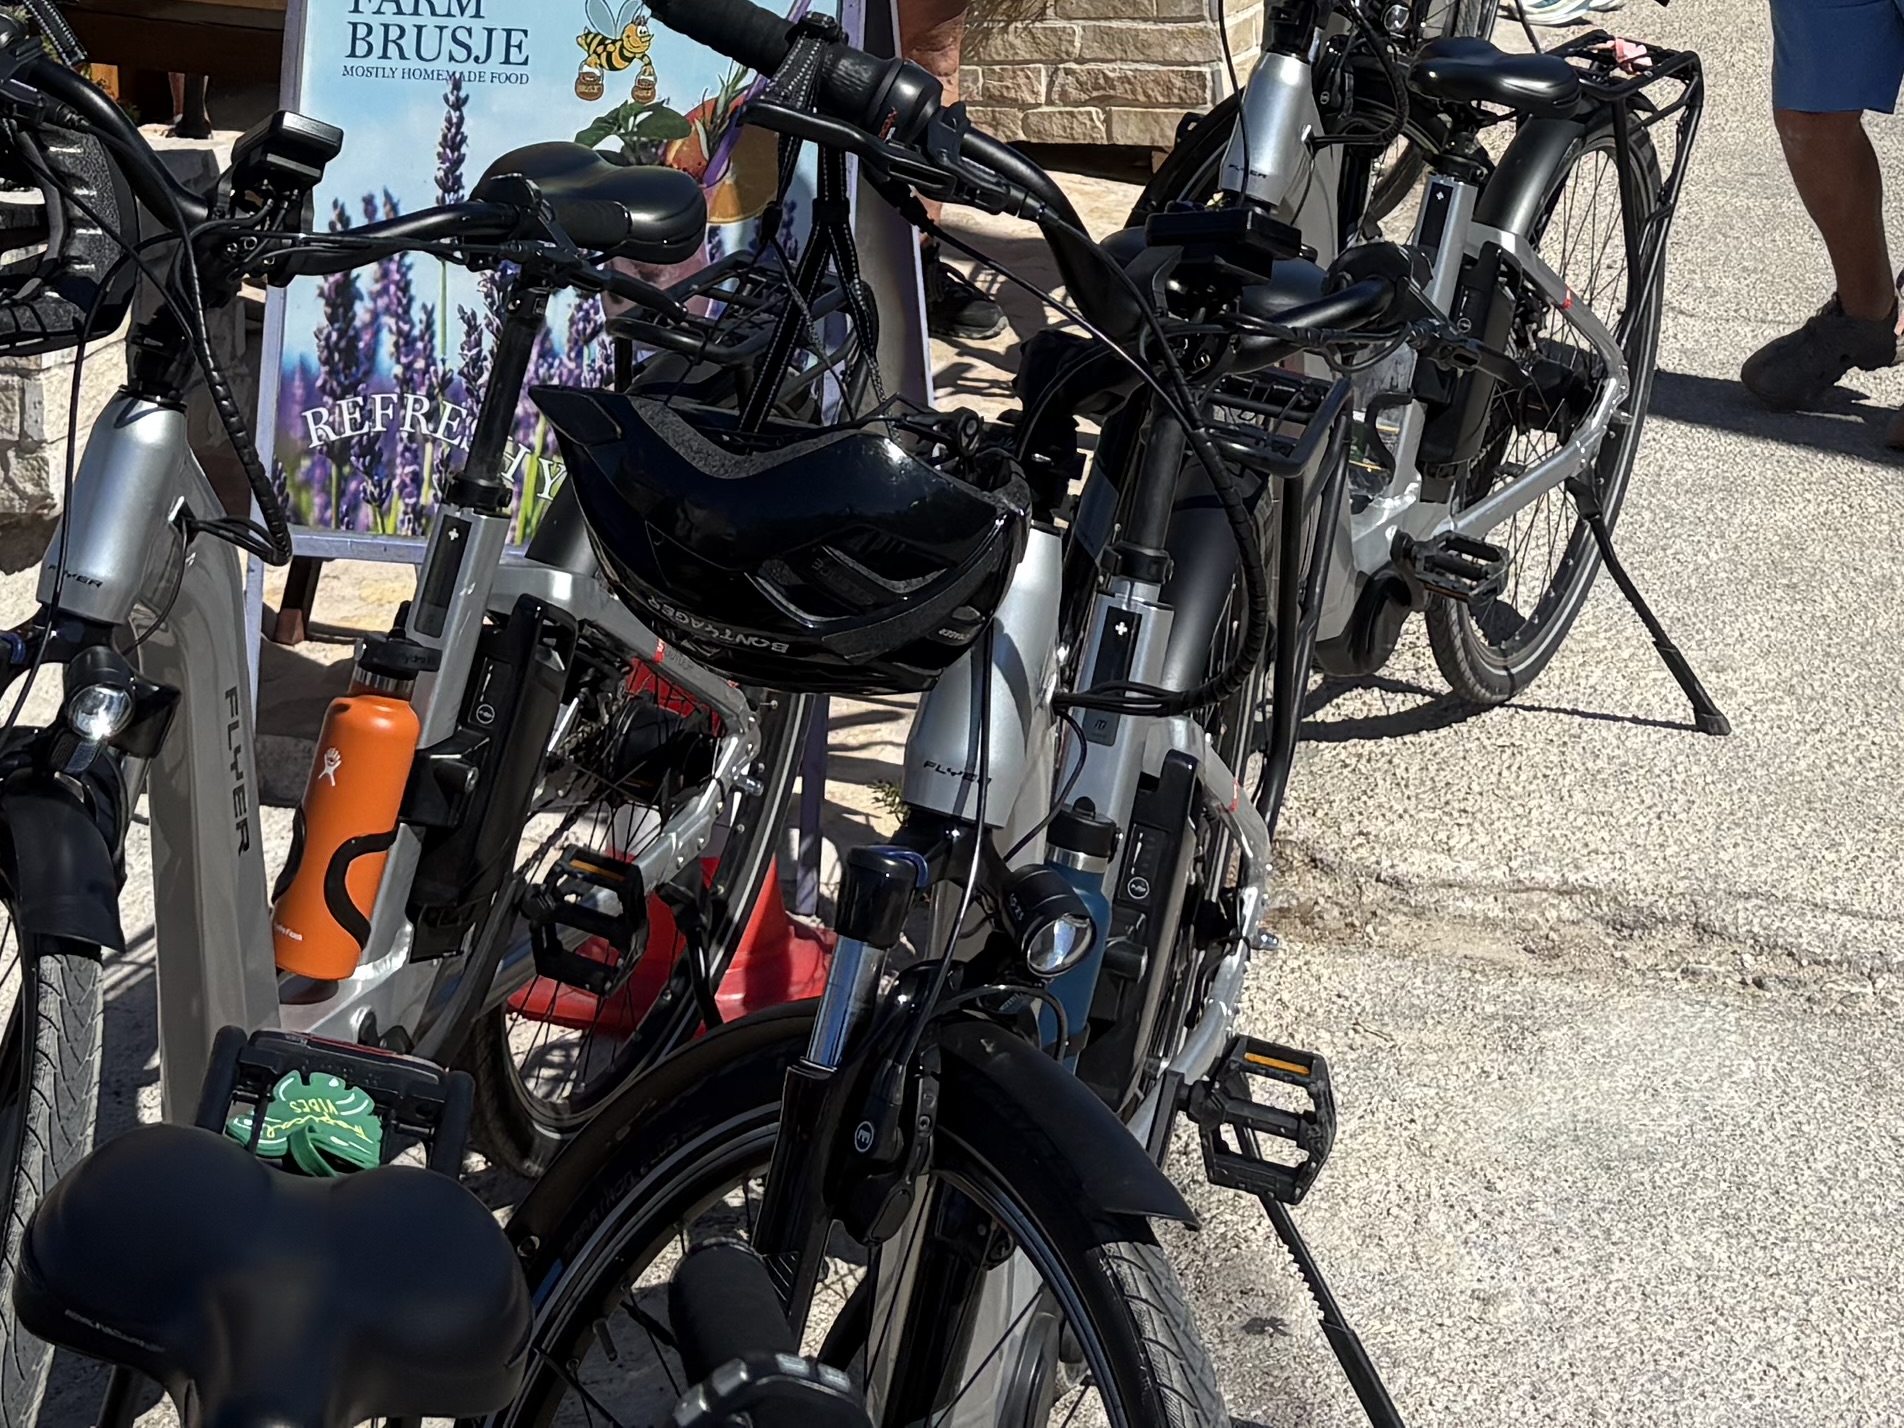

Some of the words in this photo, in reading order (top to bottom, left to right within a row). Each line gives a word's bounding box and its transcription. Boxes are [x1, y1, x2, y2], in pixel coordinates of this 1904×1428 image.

[345, 21, 530, 66] BRUSJE
[342, 65, 398, 79] MOSTLY
[401, 68, 486, 83] HOMEMADE
[490, 72, 530, 85] FOOD
[301, 393, 532, 483] REFREH
[48, 563, 104, 589] FYER
[225, 686, 251, 857] FLYER
[289, 1098, 339, 1116] VIBES
